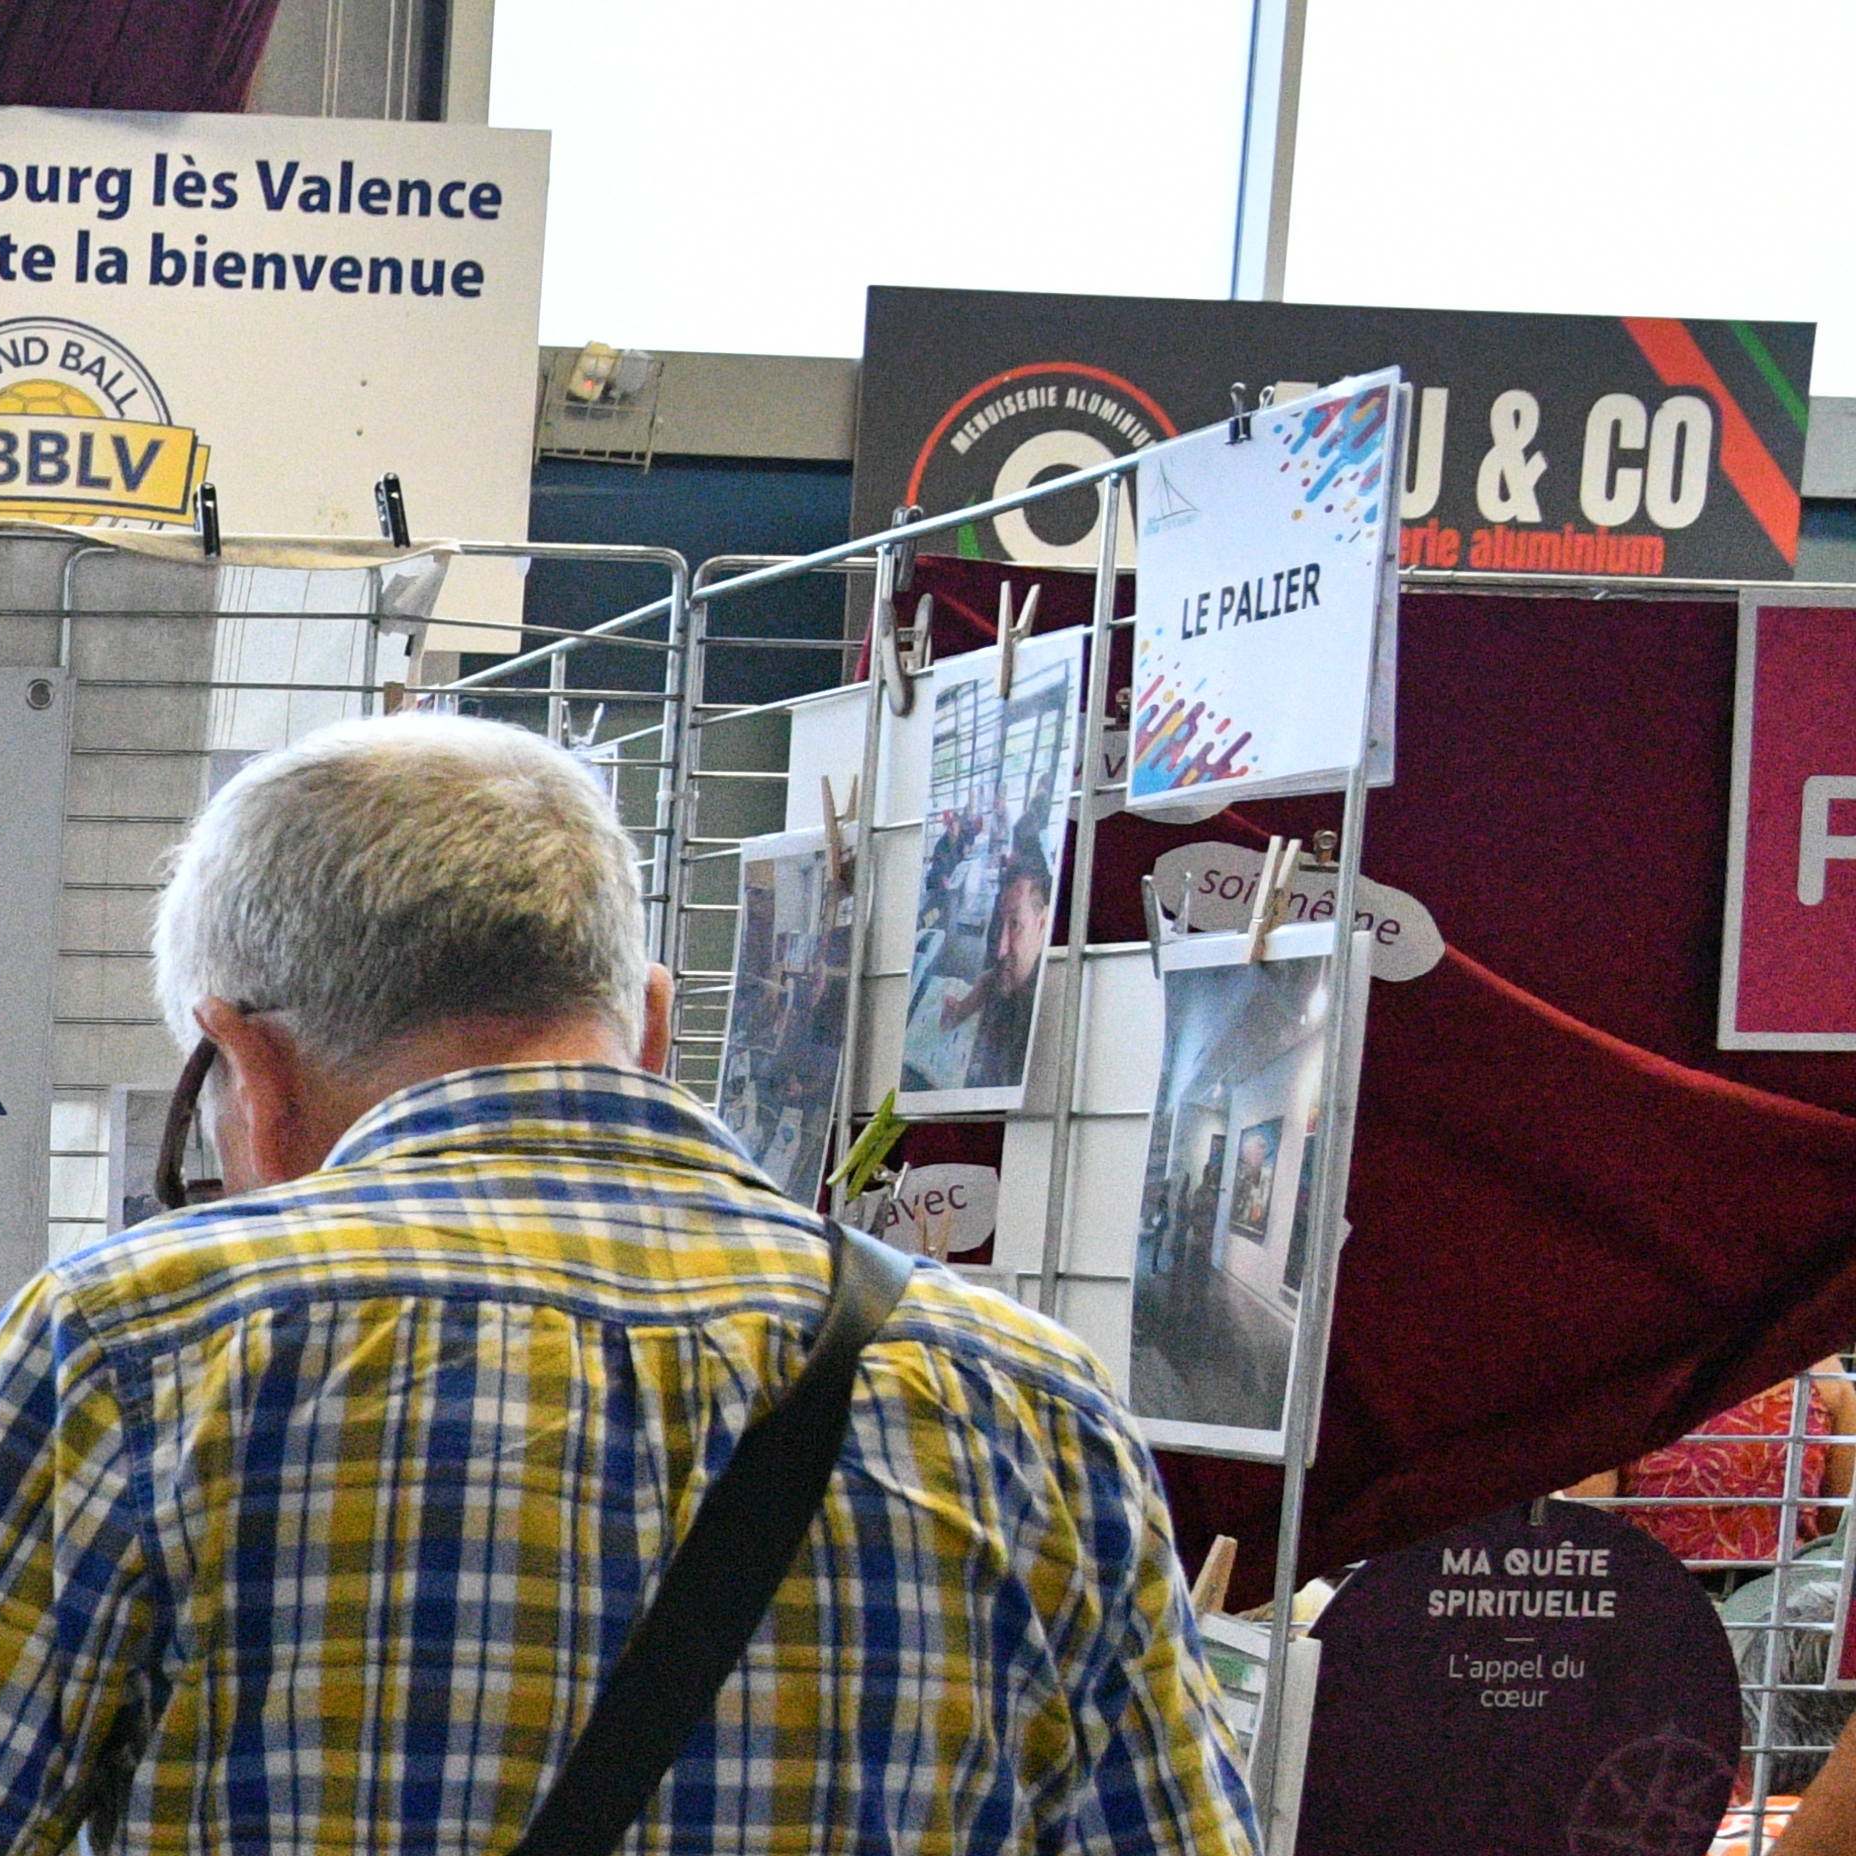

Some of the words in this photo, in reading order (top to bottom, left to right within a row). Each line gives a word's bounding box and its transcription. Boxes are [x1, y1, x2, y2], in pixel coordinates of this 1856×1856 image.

[152, 152, 239, 210] lès
[255, 159, 504, 221] Valence
[74, 229, 129, 285] la
[148, 231, 485, 298] bienvenue
[58, 340, 138, 418] BALL
[950, 385, 1059, 455] MENUISERIE
[1065, 386, 1157, 450] ALUMINIU
[1475, 389, 1548, 523] &
[1579, 392, 1713, 530] CO
[1469, 522, 1665, 575] aluminium
[1181, 591, 1211, 641] LE
[1217, 562, 1321, 631] PALIER
[1441, 1547, 1492, 1576] MA
[1503, 1540, 1611, 1578] QUÊTE
[1427, 1588, 1618, 1618] SPIRITUELLE
[1448, 1653, 1544, 1684] L'appel
[1551, 1653, 1586, 1679] du
[1479, 1688, 1550, 1708] cœur
